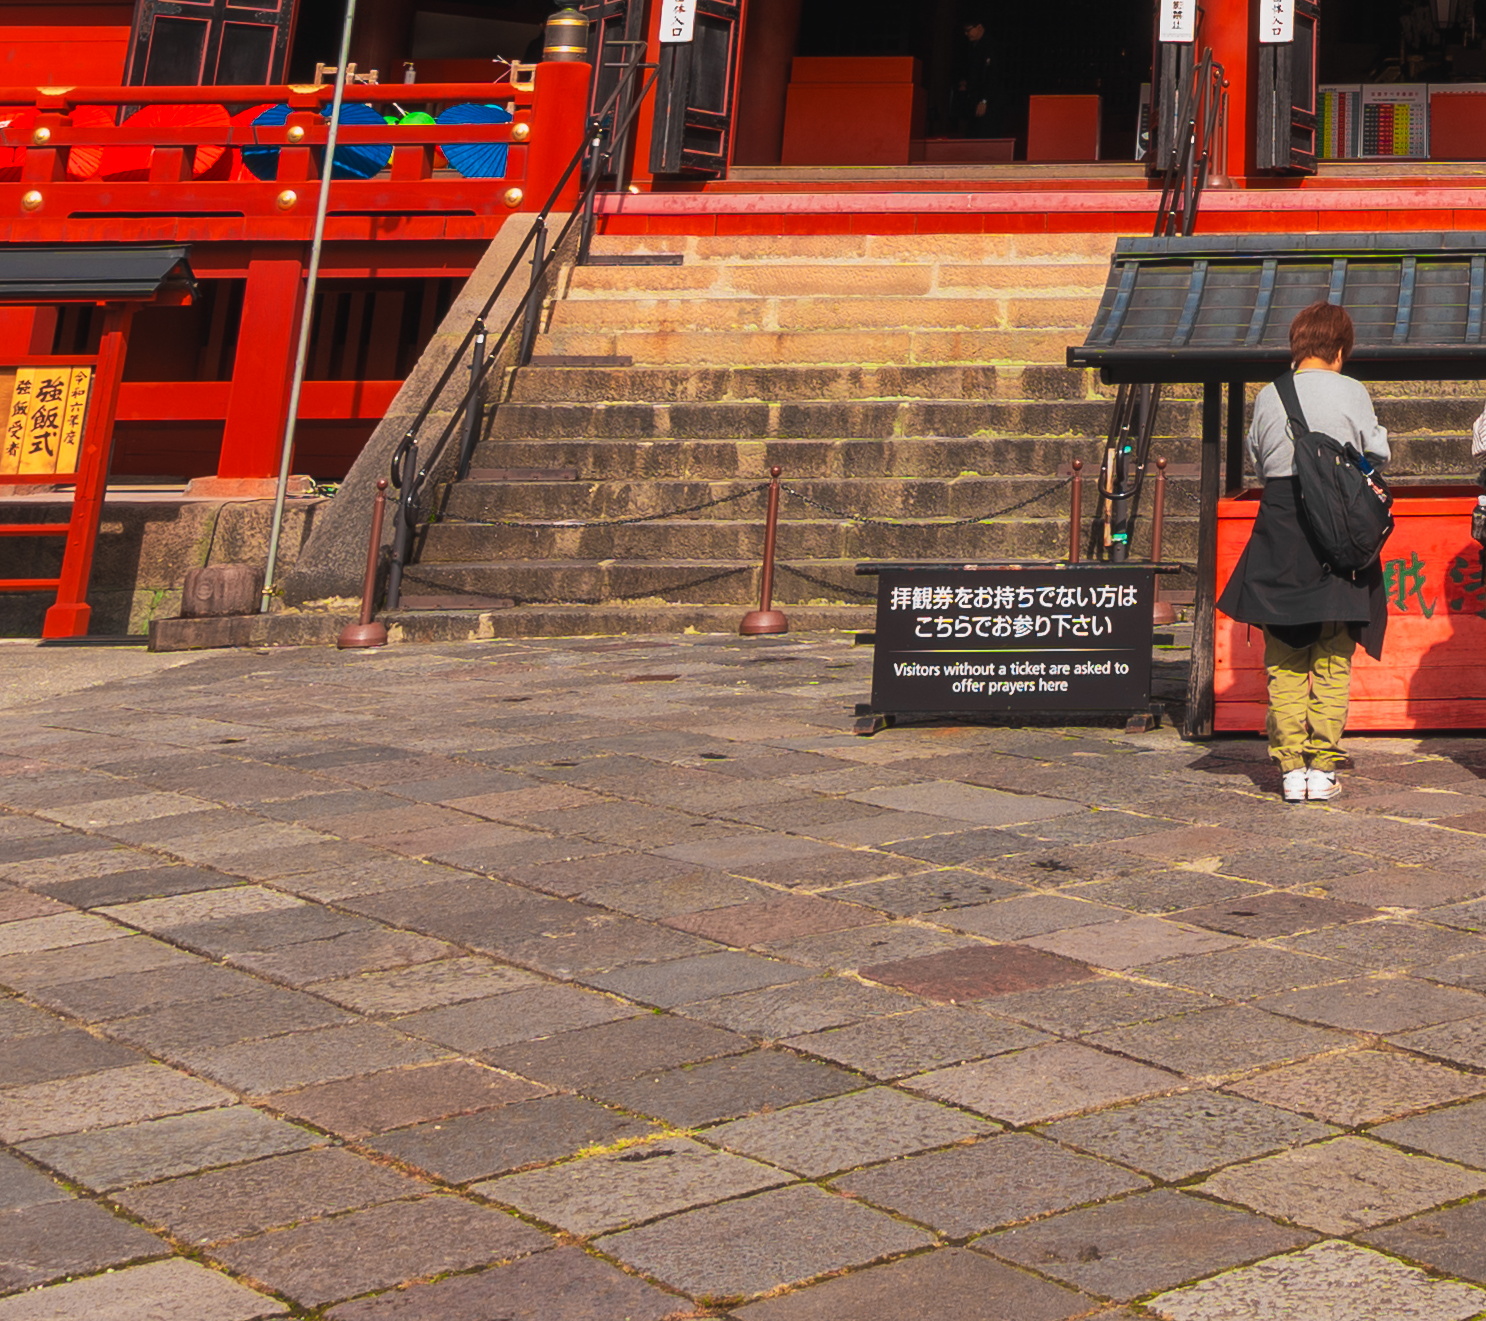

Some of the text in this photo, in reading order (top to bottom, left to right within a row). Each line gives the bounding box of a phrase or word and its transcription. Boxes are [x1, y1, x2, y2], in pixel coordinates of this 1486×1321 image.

[6, 380, 32, 457] 強飯受者
[29, 376, 64, 457] 強飯式
[890, 584, 1138, 611] 拝観券をお持ちでない方は
[914, 614, 1113, 638] こちらでお参り下さい
[893, 661, 1130, 677] Visitors without a ticket are asked to
[952, 678, 1069, 695] offer prayers here
